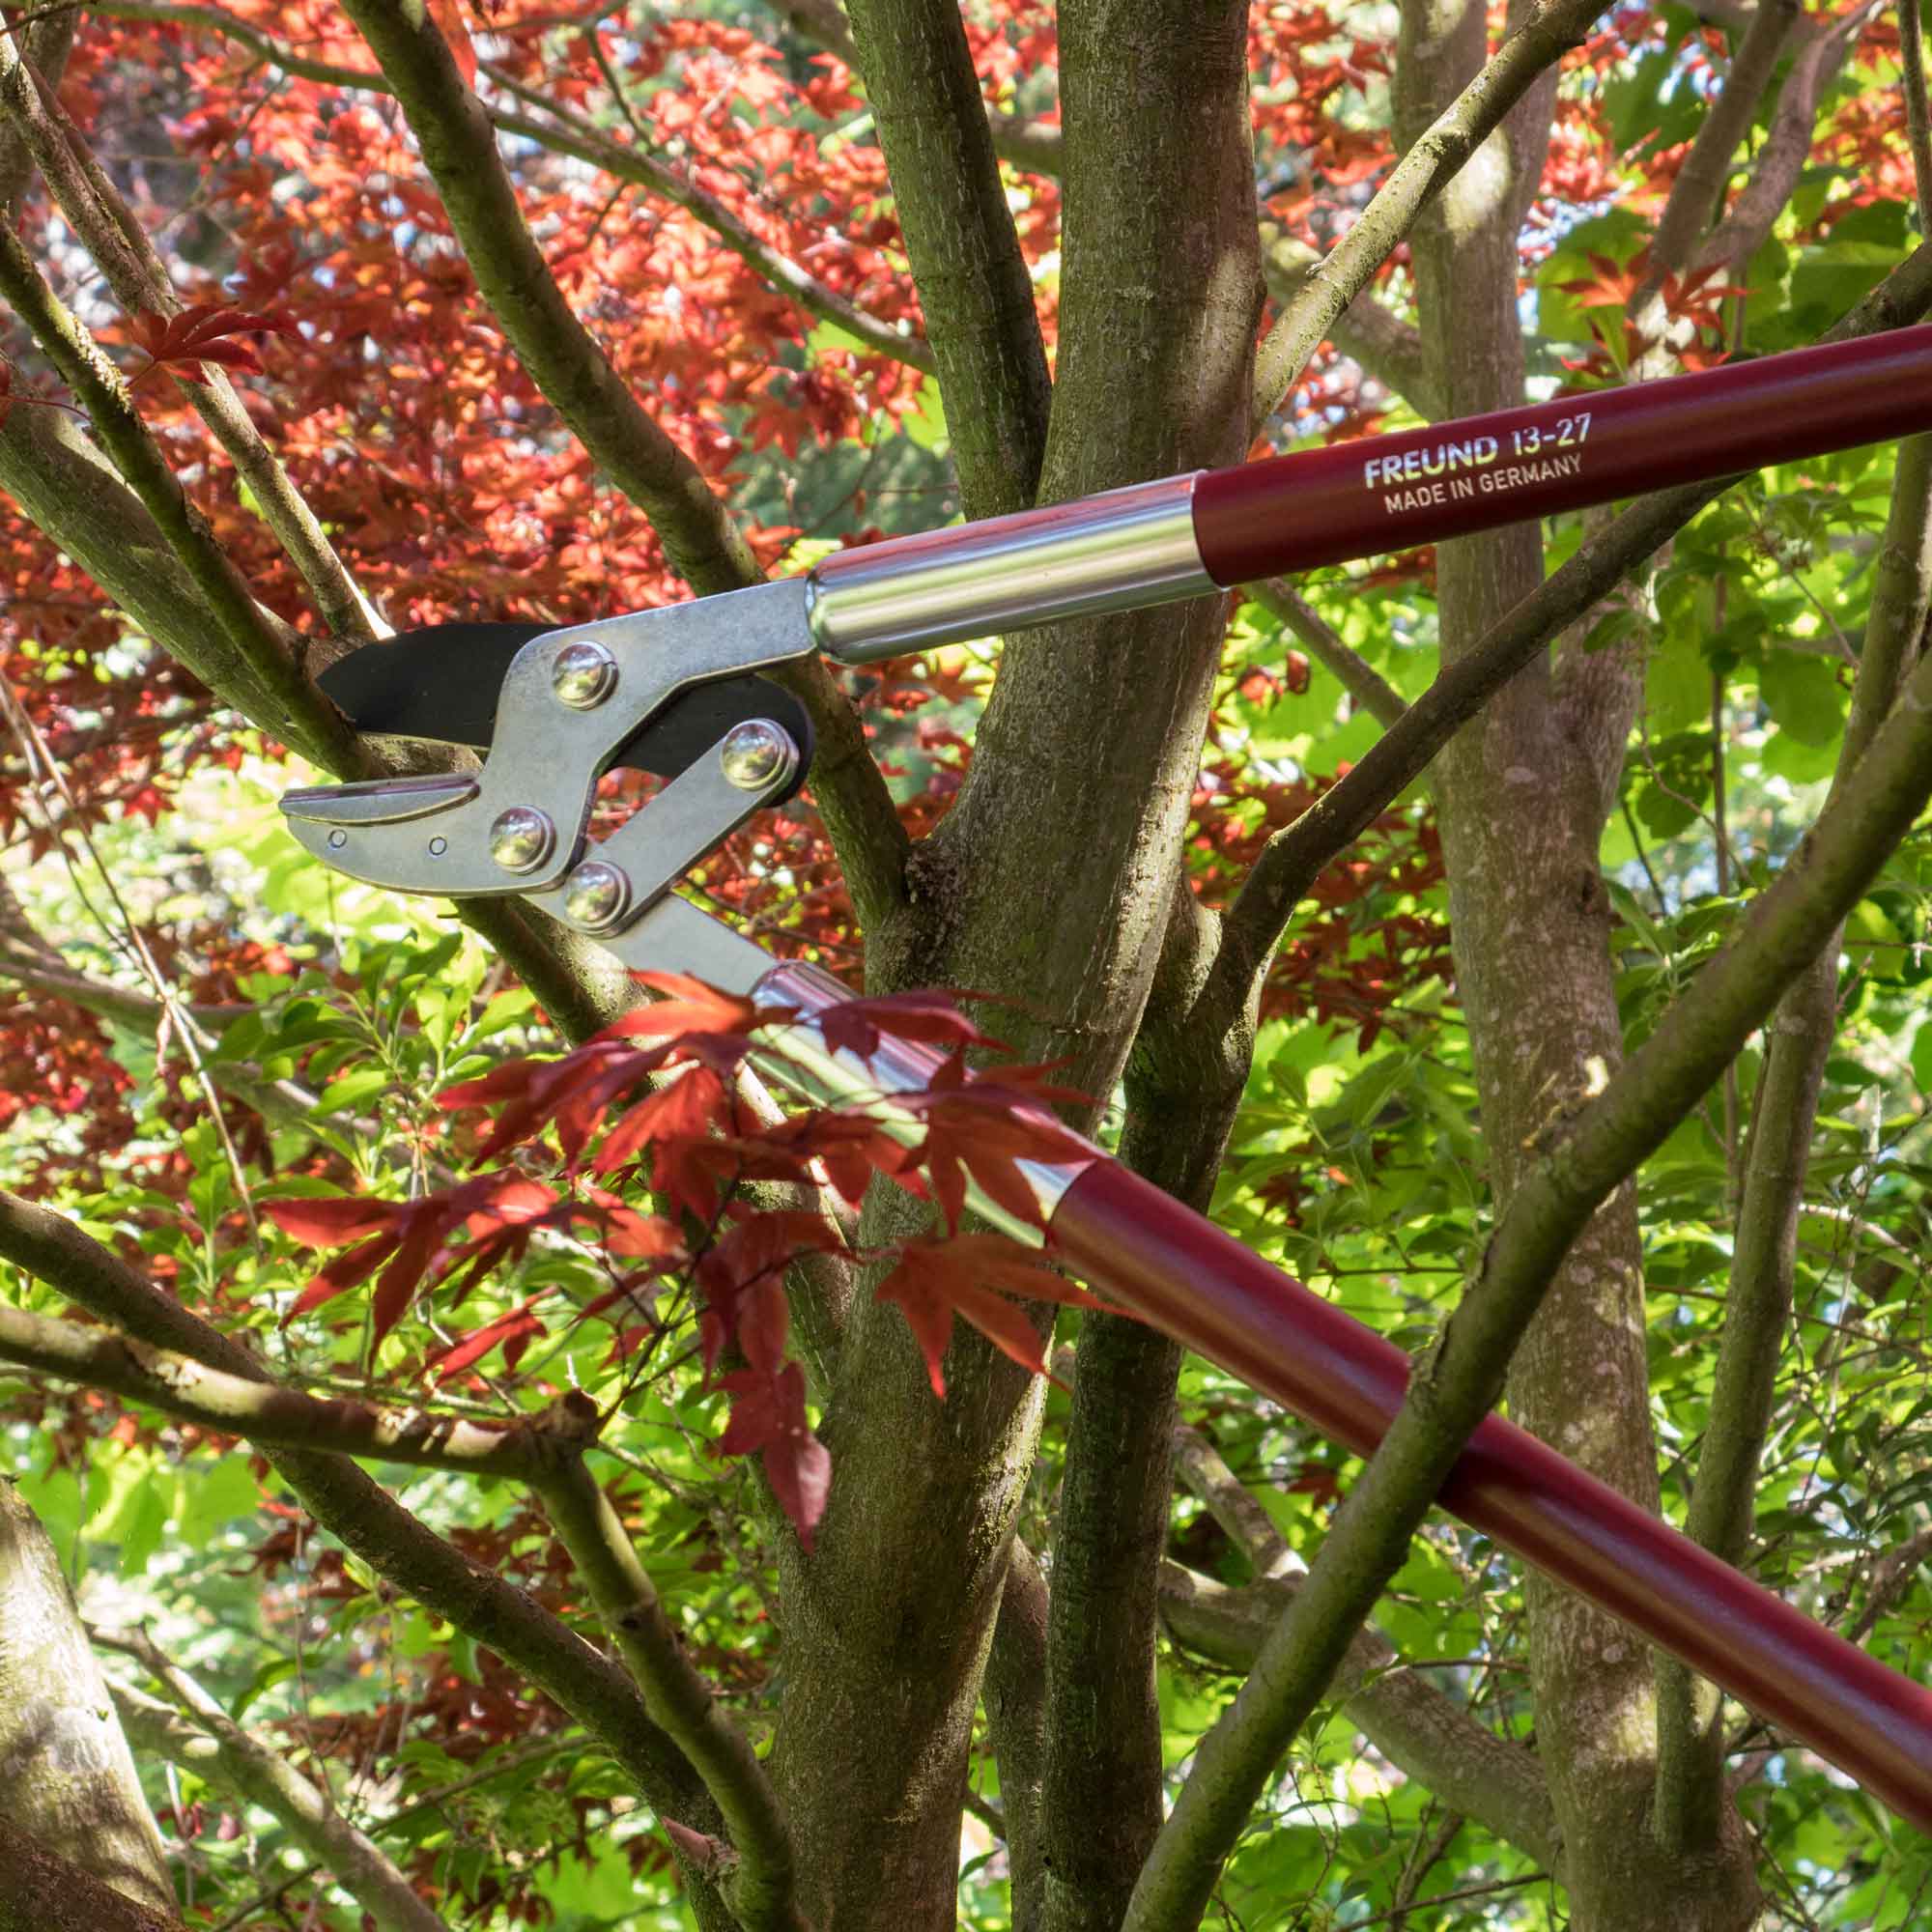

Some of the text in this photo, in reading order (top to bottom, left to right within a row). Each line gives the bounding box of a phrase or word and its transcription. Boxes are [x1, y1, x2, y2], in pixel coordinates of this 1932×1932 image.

[1364, 412, 1592, 489] FREUND 13-27
[1384, 452, 1582, 514] MADE IN GERMANY
